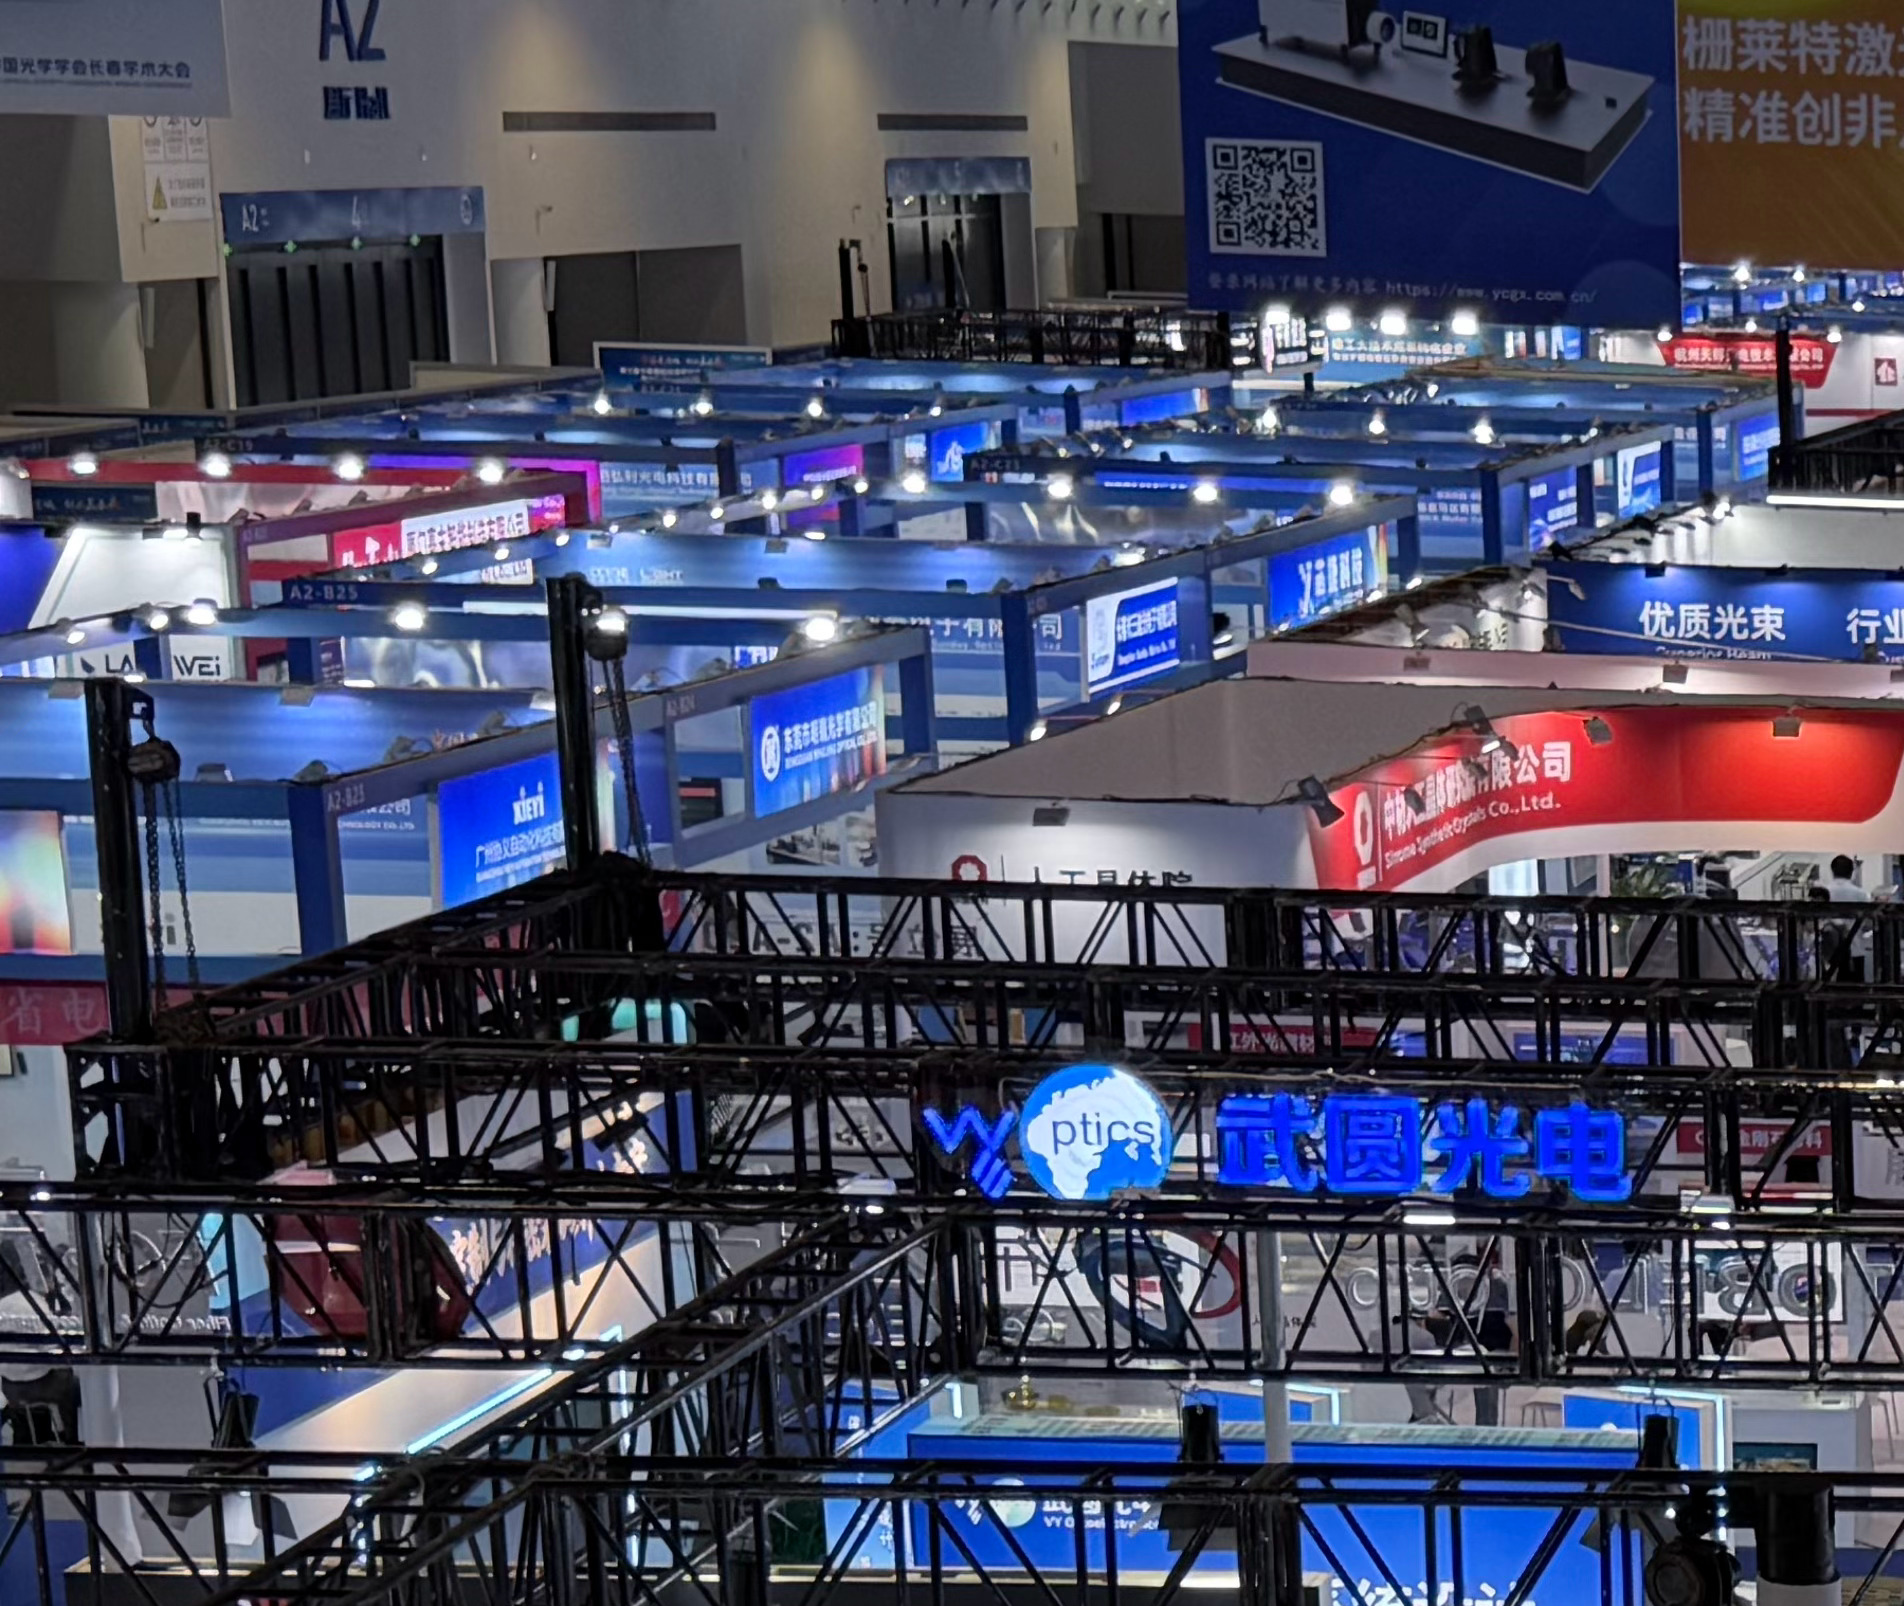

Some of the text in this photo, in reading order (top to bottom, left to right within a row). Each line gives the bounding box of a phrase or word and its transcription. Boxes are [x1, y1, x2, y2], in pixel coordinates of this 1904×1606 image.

[289, 583, 358, 601] A2-B25
[1638, 600, 1784, 642] 优质光束
[1213, 1093, 1630, 1199] 武圆光电
